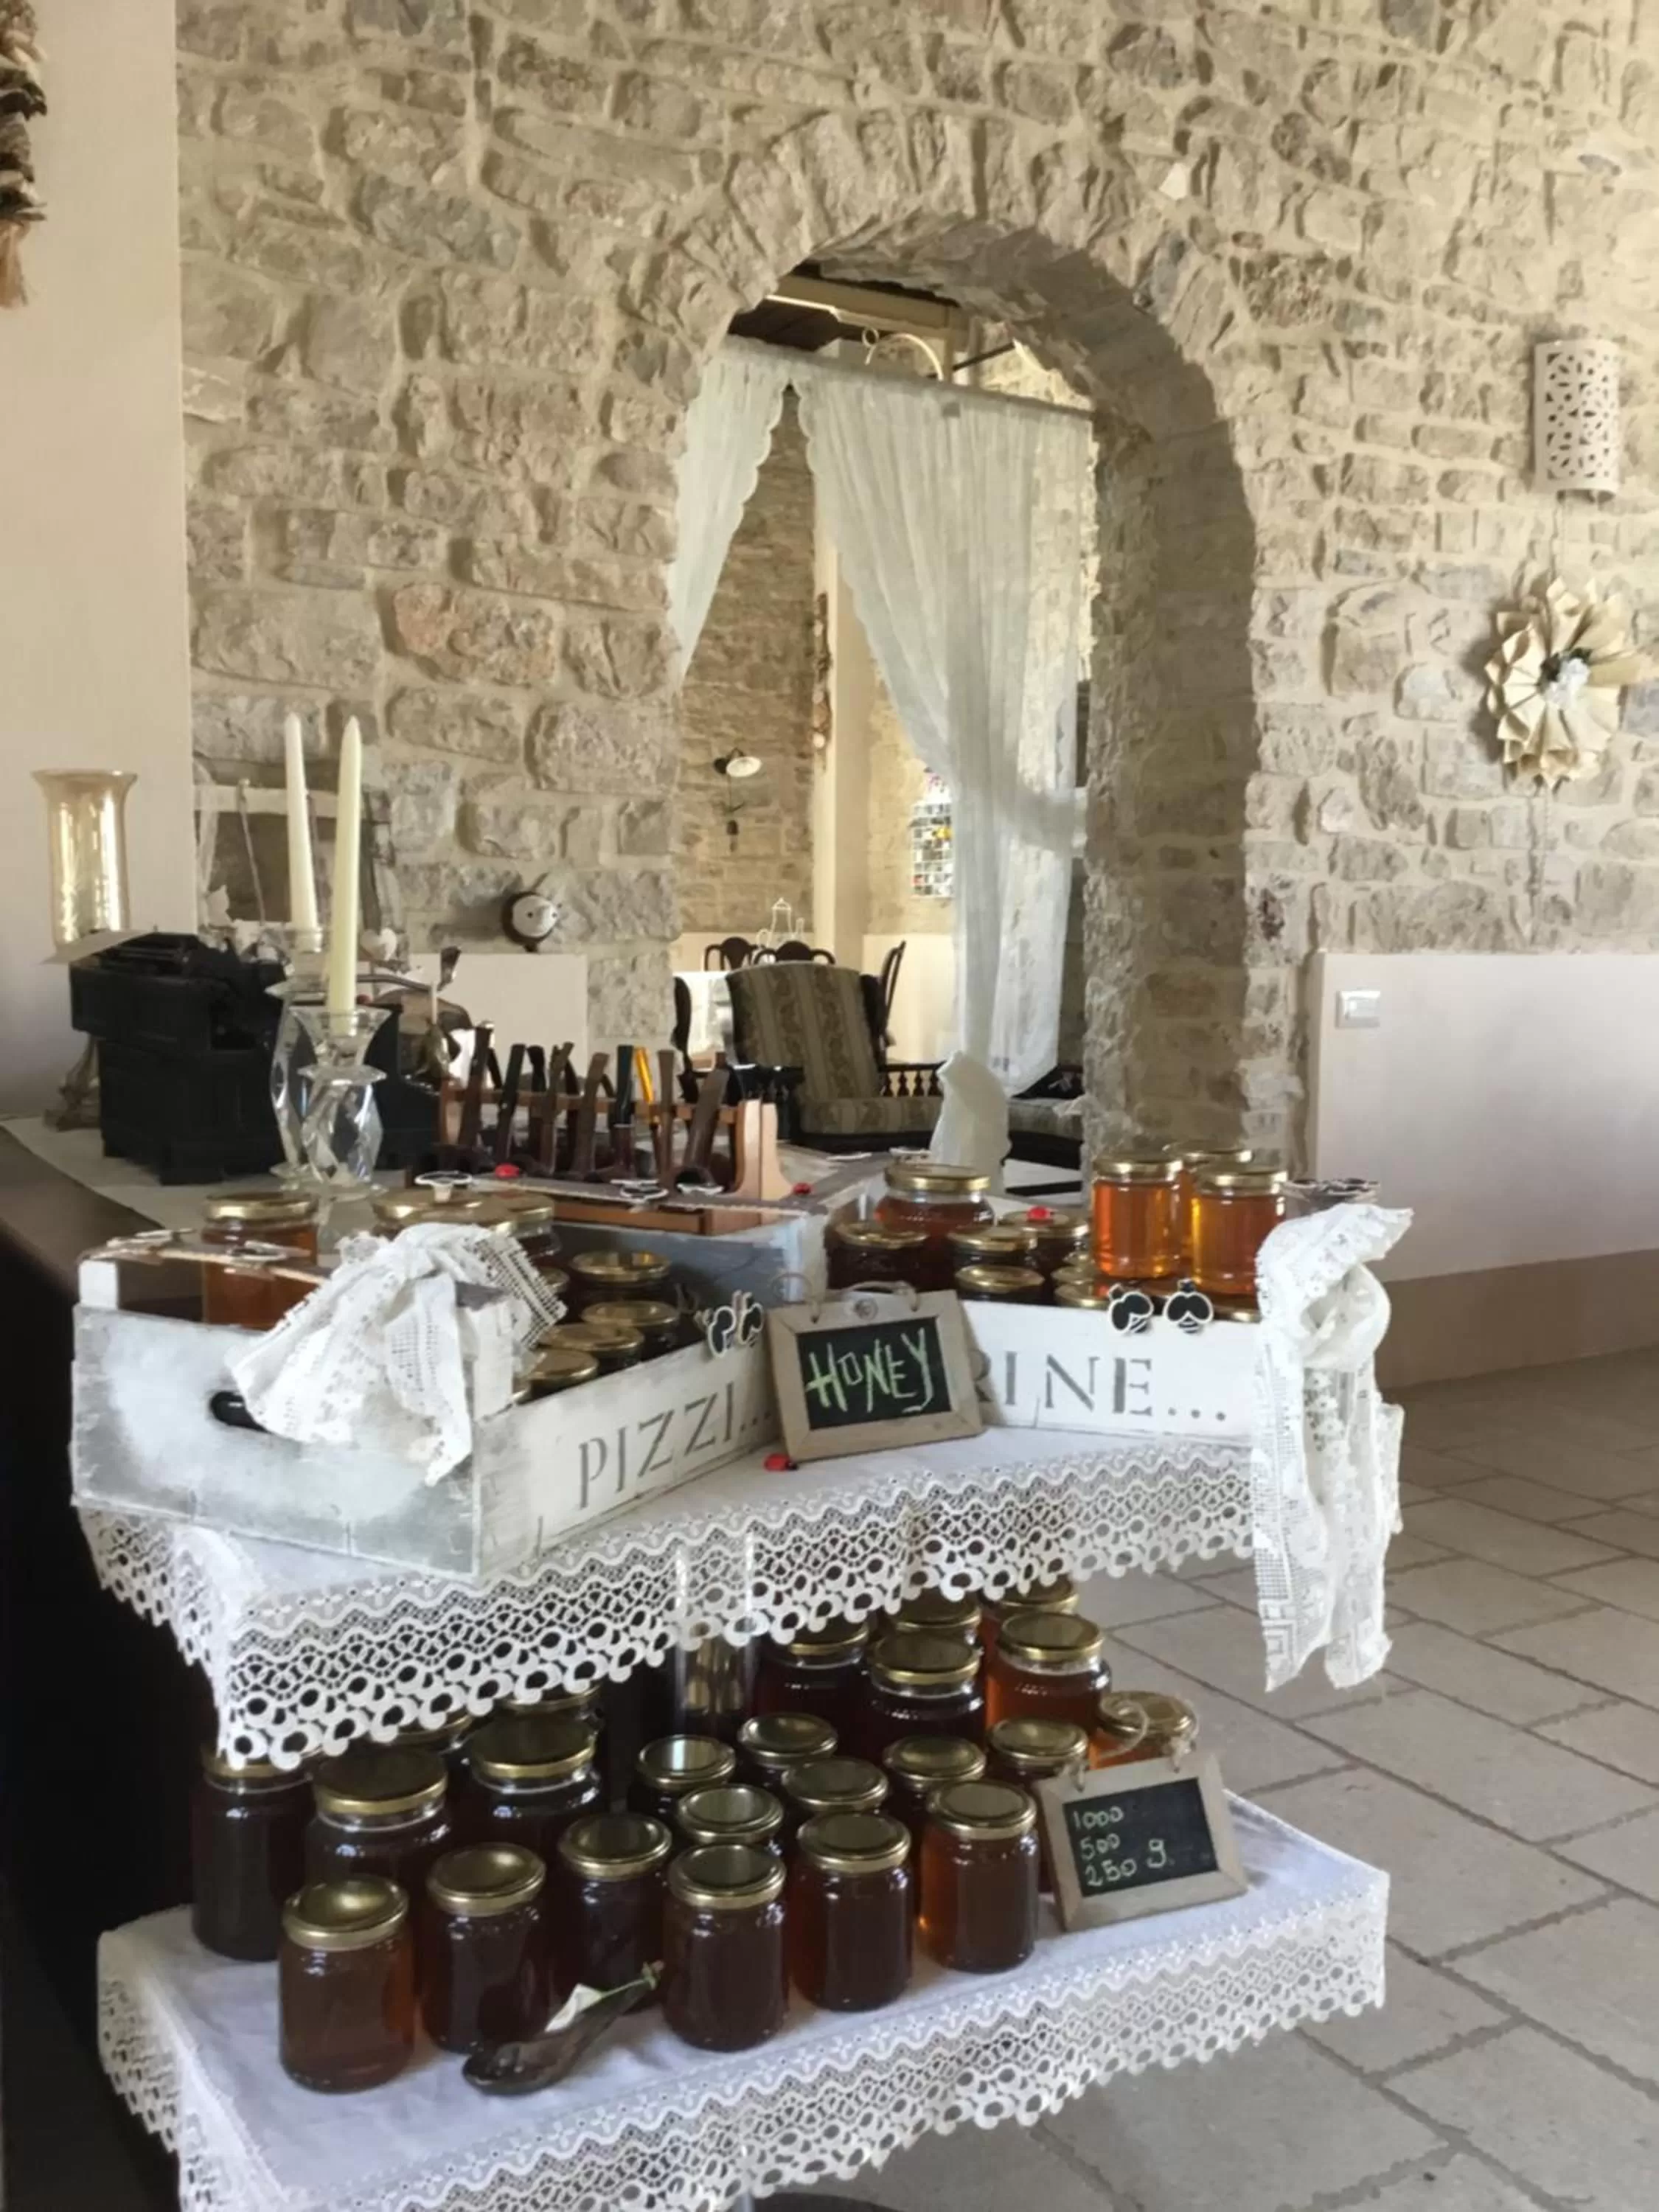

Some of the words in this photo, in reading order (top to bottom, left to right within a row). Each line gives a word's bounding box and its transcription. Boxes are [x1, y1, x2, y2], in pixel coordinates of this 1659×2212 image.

[807, 1328, 934, 1413] HONEY
[1073, 1806, 1124, 1829] 1000
[1079, 1833, 1121, 1860] 500
[1085, 1858, 1138, 1886] 250
